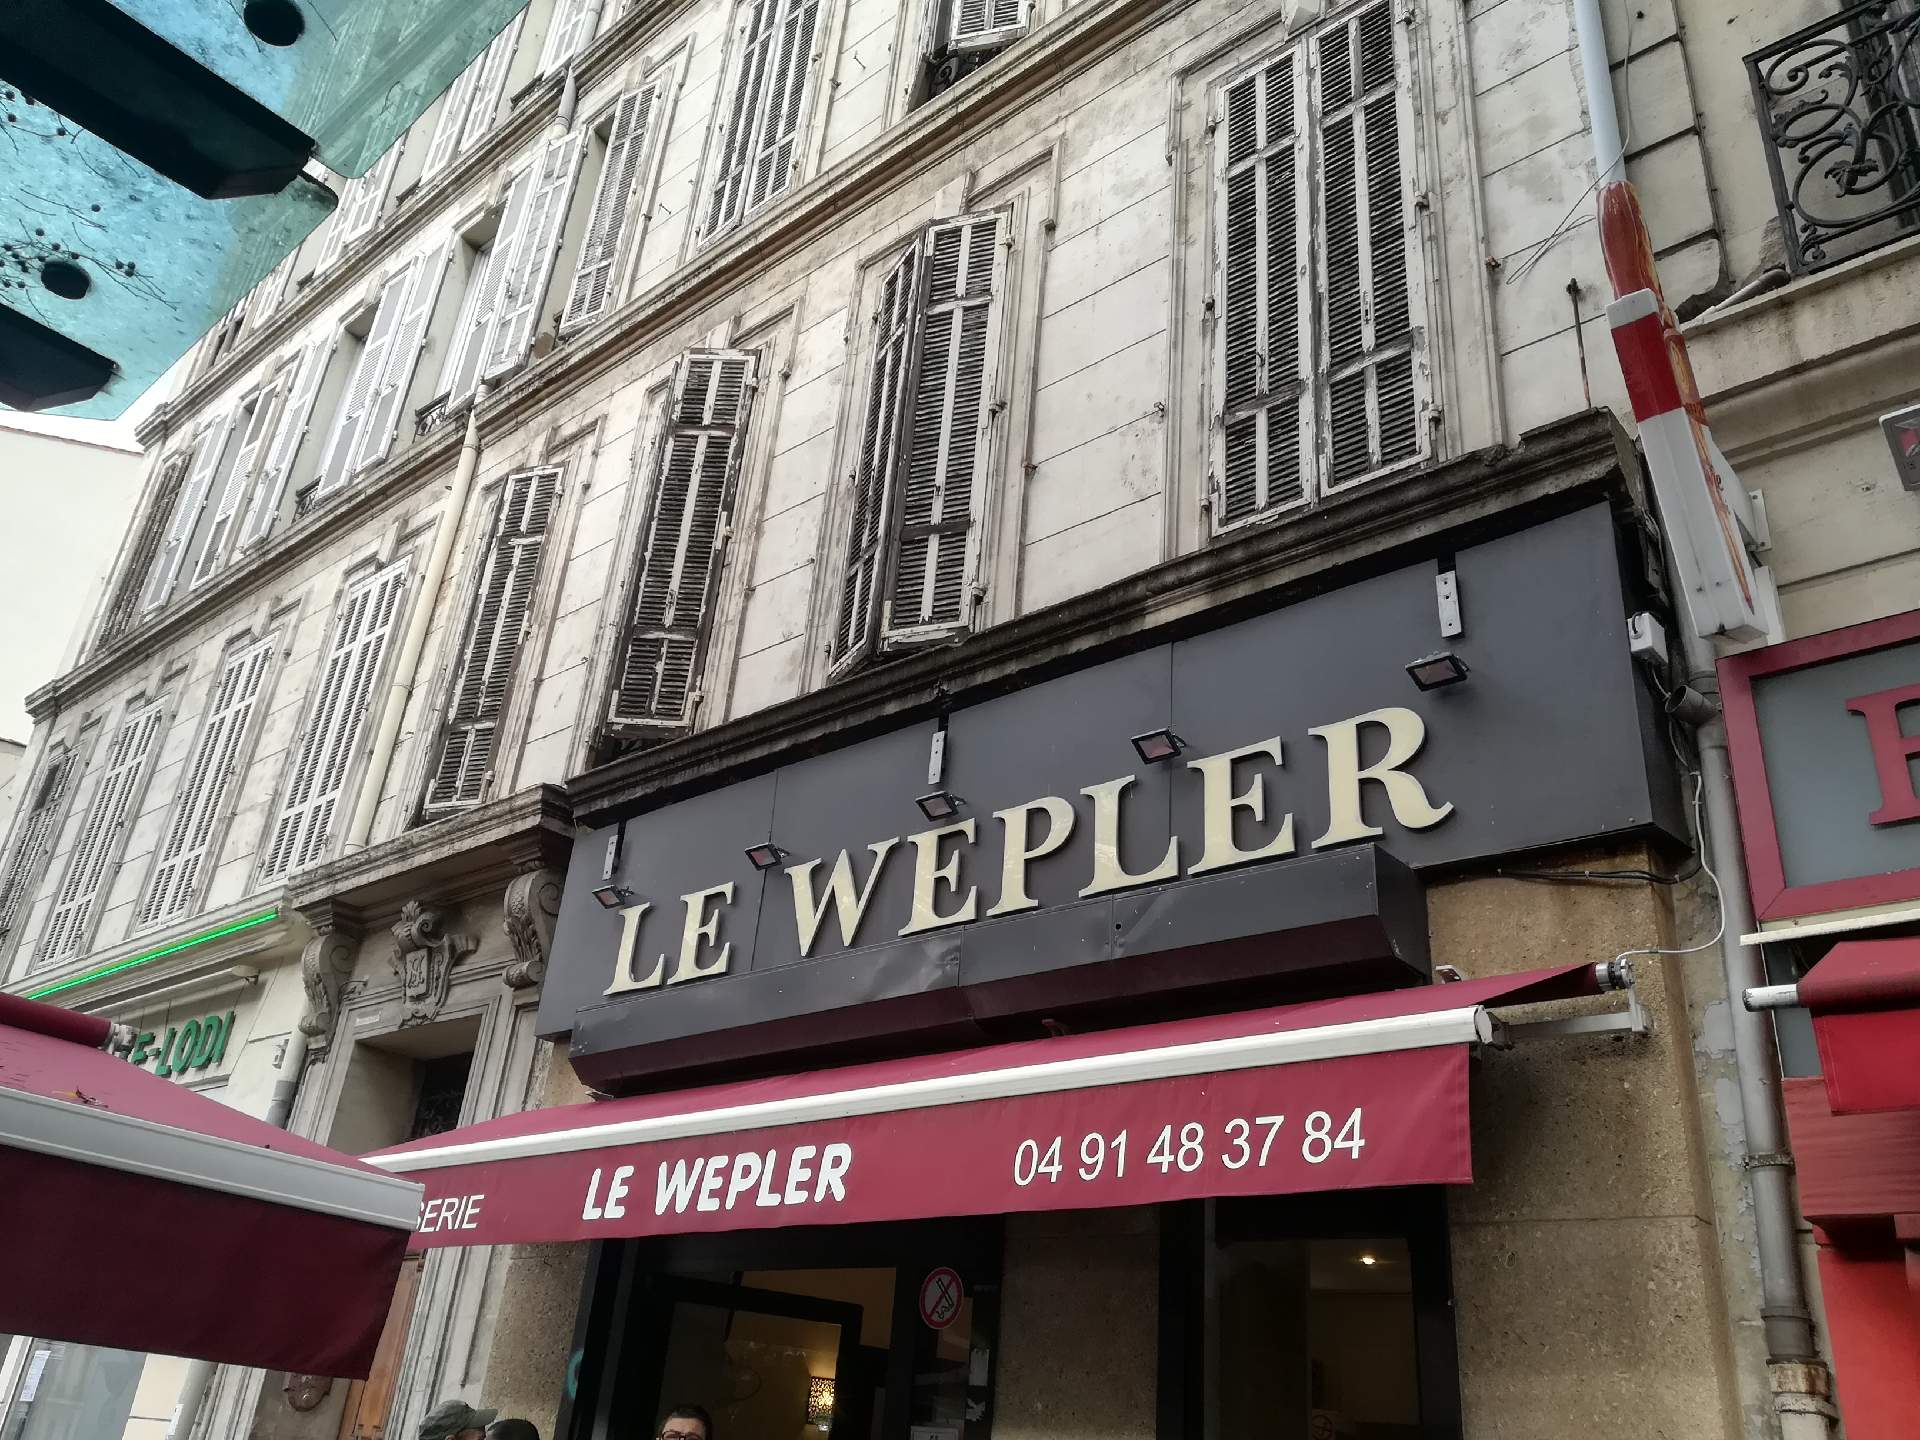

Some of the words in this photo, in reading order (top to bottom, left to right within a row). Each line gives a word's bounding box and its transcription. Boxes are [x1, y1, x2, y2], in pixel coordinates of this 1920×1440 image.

[603, 880, 735, 997] LE
[784, 705, 1456, 958] WEPLER
[121, 1010, 234, 1077] E-LODI
[582, 1165, 635, 1221] LE
[655, 1142, 852, 1216] WEPLER
[1013, 1135, 1063, 1187] 04
[1078, 1129, 1128, 1182] 91
[1146, 1121, 1204, 1174] 48
[1221, 1115, 1285, 1170] 37
[1301, 1107, 1366, 1164] 84
